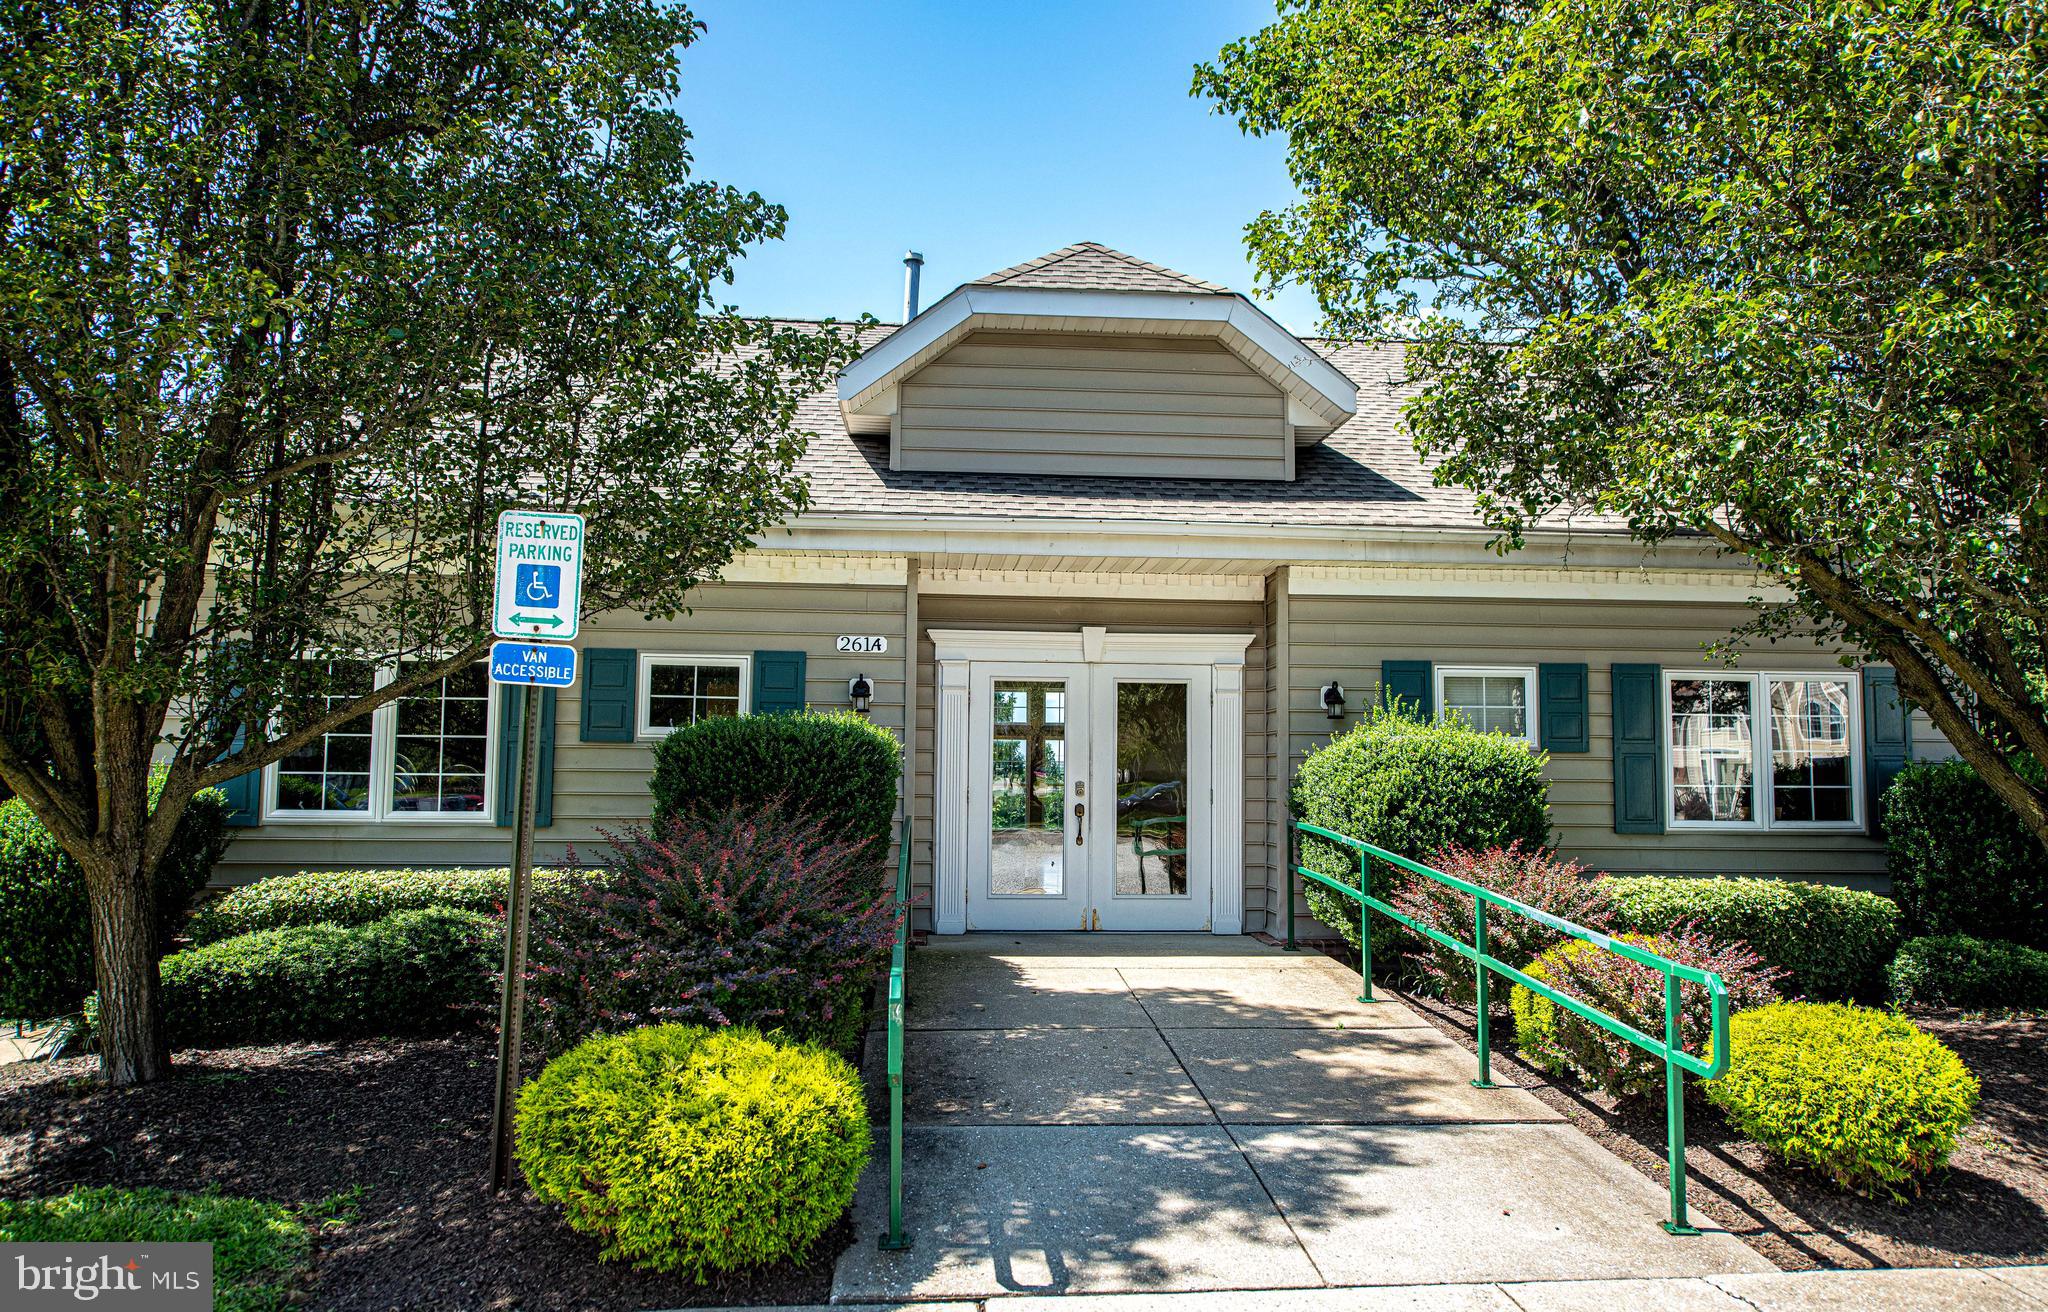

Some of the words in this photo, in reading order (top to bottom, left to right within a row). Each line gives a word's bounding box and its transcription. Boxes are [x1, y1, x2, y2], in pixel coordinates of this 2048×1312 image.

[505, 521, 578, 540] RESERVED
[509, 543, 572, 561] PARKING
[522, 650, 547, 663] VAN
[494, 664, 571, 679] ACCESSIBLE
